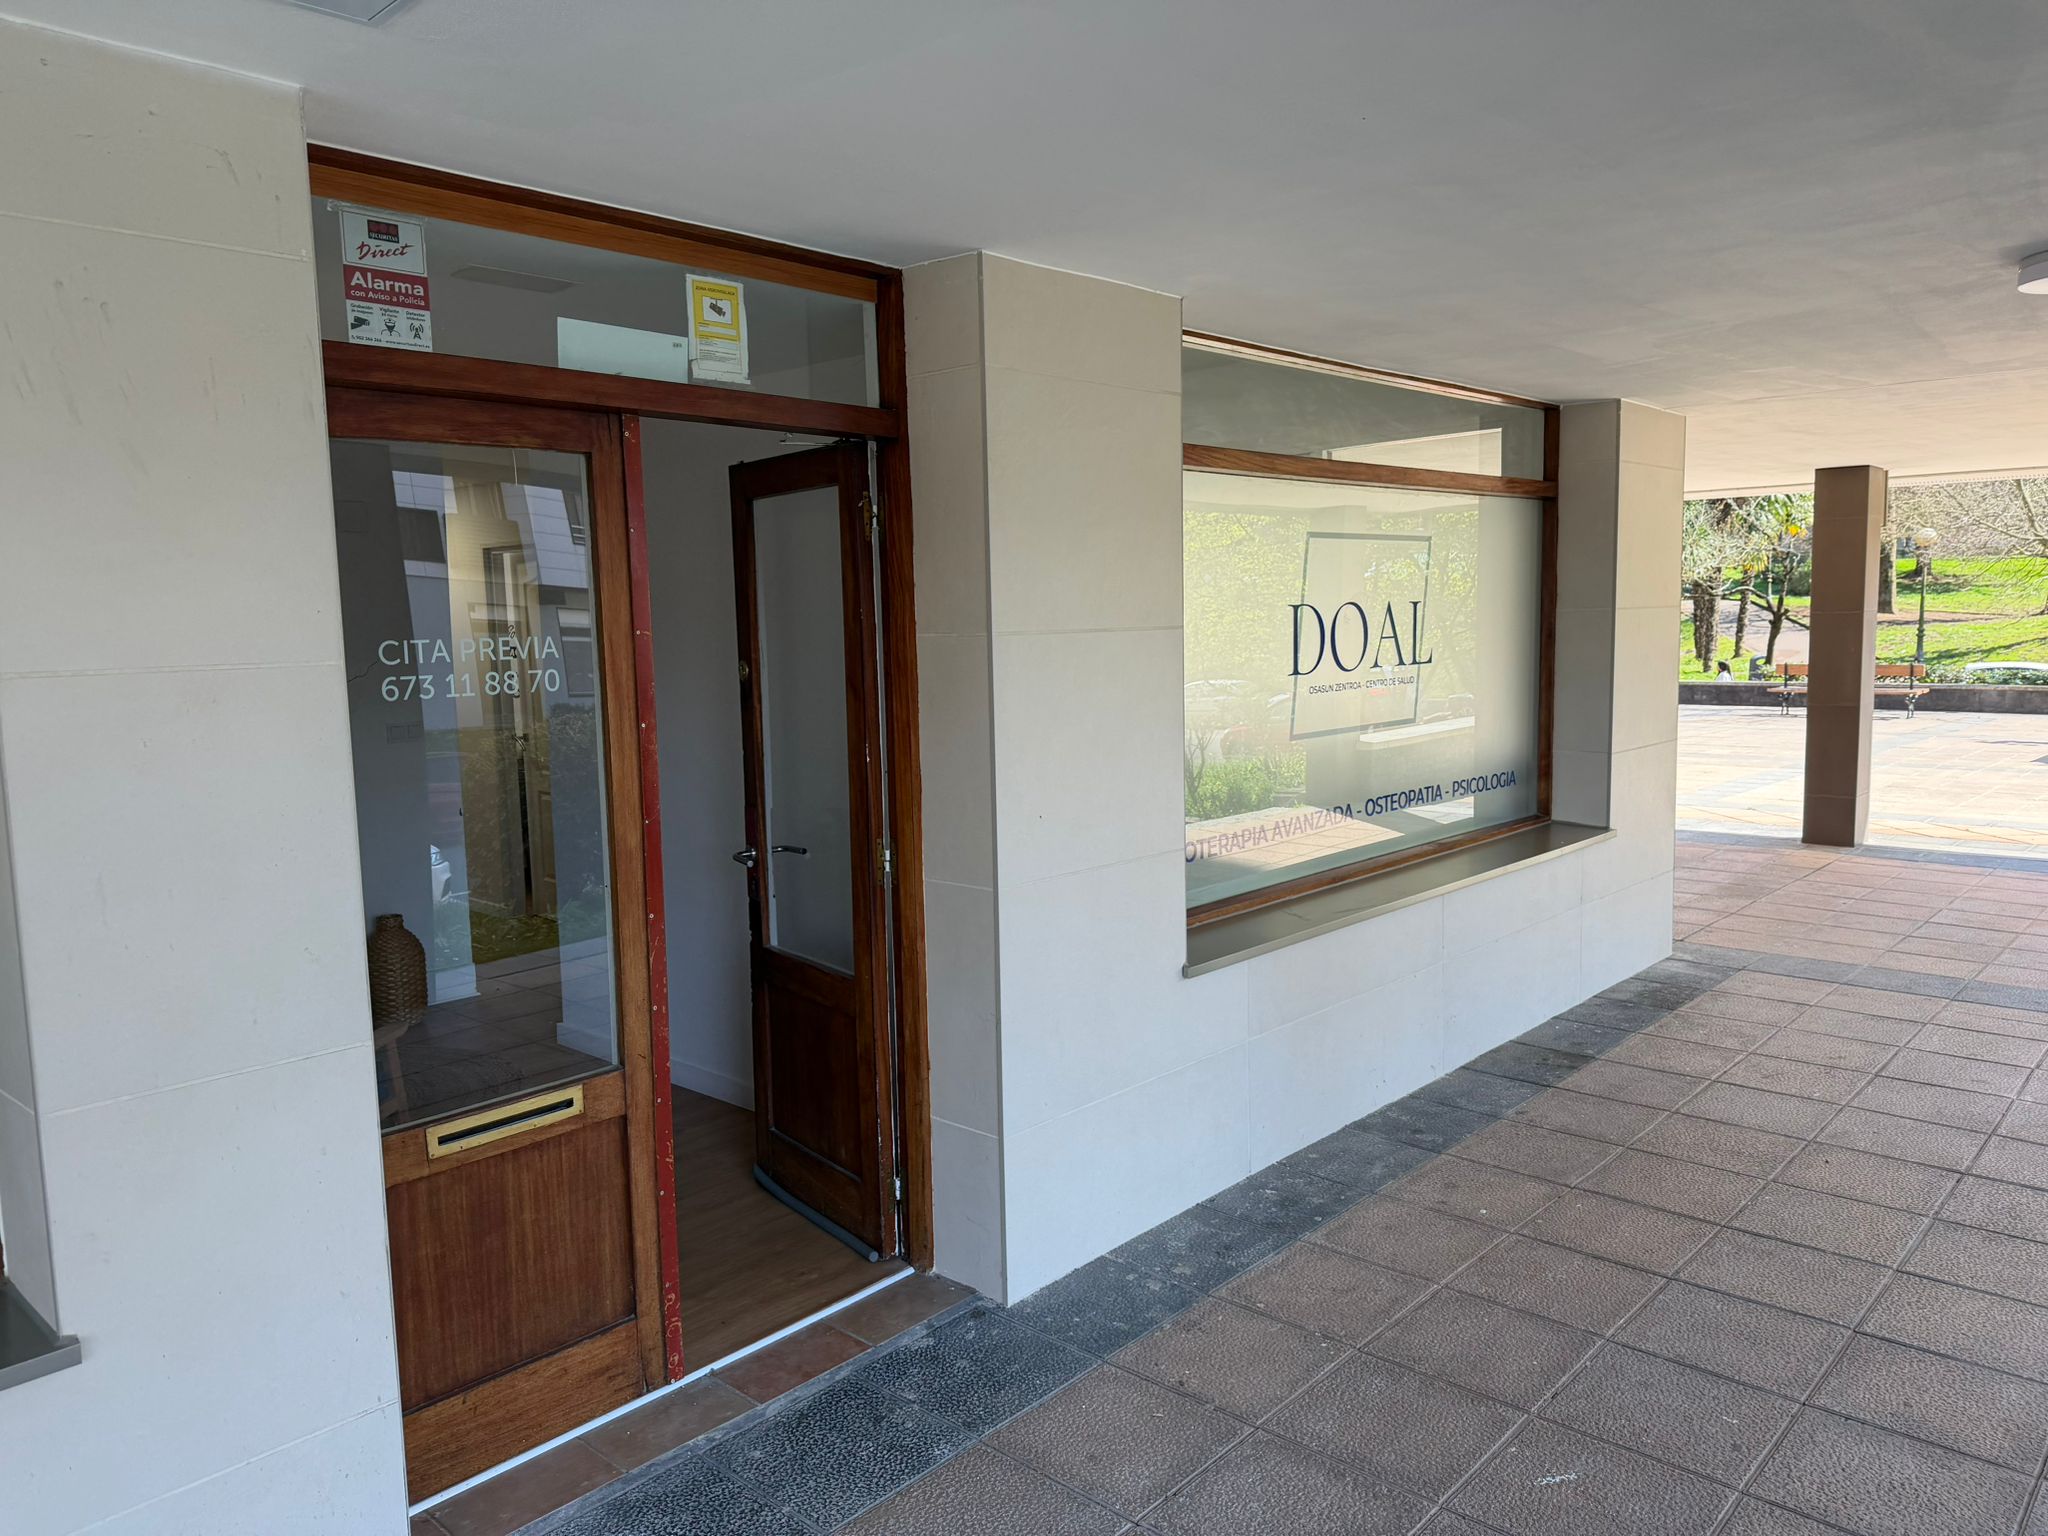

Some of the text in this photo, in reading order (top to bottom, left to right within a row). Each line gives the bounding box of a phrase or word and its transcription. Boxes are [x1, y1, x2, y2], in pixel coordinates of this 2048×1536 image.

[356, 241, 415, 260] Direct
[350, 271, 425, 297] Alarma
[350, 289, 366, 297] con
[367, 291, 390, 301] Aviso
[378, 636, 560, 666] CITA PREVIA
[1287, 600, 1433, 677] DOAL
[381, 668, 561, 702] 673 11 88 70
[1308, 684, 1334, 695] OSASUN
[1334, 682, 1361, 692] ZENTROA
[1365, 678, 1388, 689] CENTRO
[1388, 677, 1396, 687] DE
[1271, 803, 1355, 838] AVANZADA
[1365, 784, 1443, 818] OSTEOPATIA
[1451, 770, 1516, 798] PSICOLOGIA
